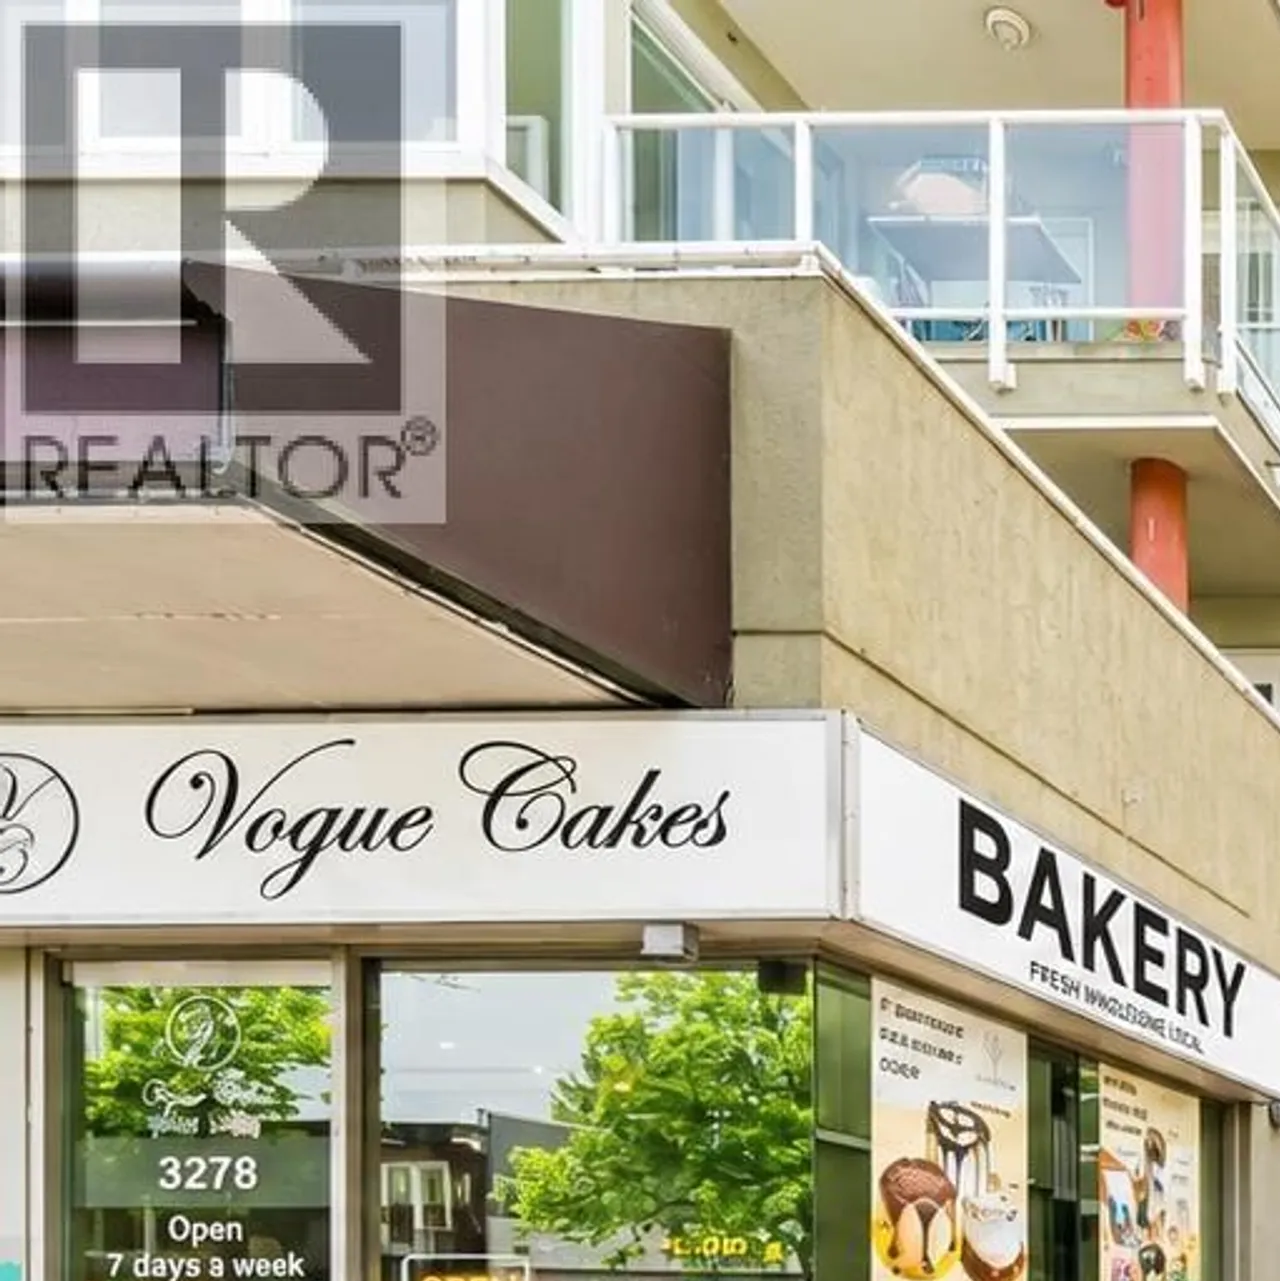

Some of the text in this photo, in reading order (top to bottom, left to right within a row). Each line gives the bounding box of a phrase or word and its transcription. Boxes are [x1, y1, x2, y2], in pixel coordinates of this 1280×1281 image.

[145, 739, 434, 901] Vogue
[458, 740, 733, 853] Cakes
[957, 797, 1247, 1039] BAKERY
[158, 1155, 259, 1191] 3278
[168, 1214, 244, 1244] Open
[106, 1253, 122, 1278] 7
[209, 1259, 225, 1278] a
[232, 1253, 306, 1278] week
